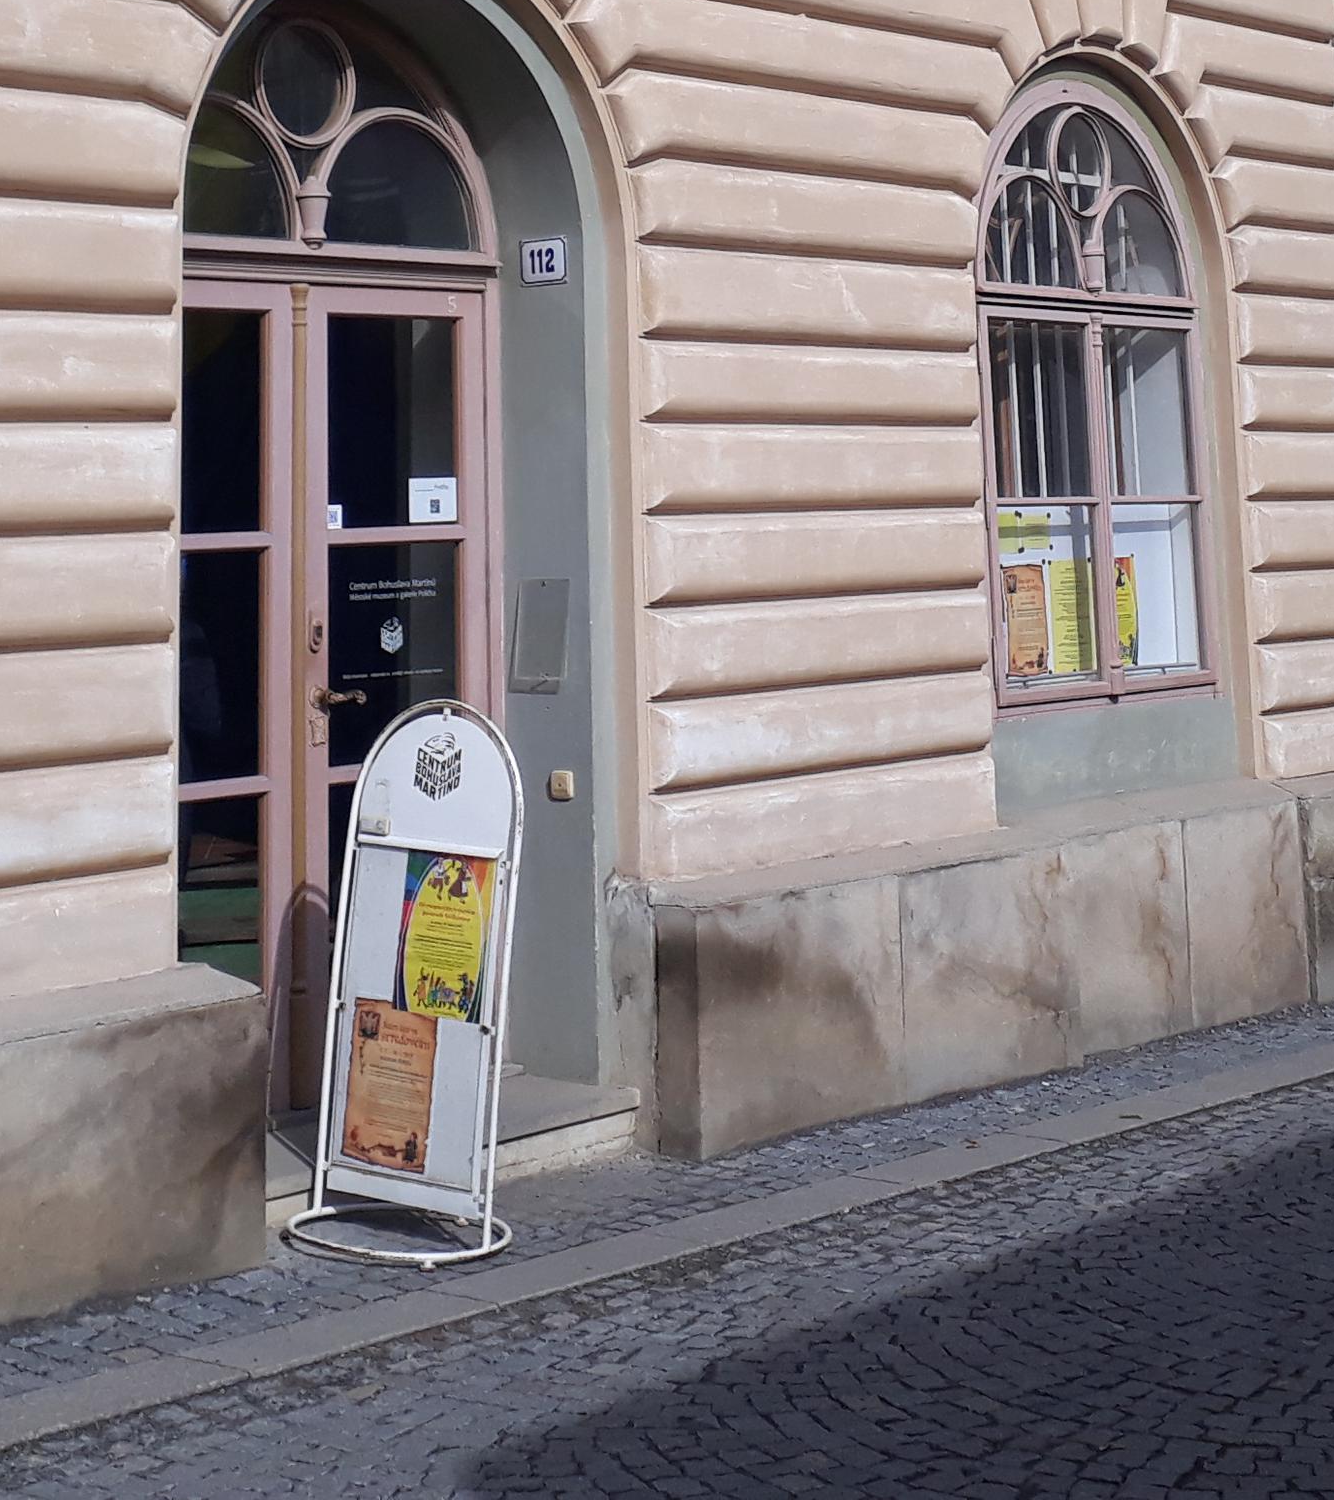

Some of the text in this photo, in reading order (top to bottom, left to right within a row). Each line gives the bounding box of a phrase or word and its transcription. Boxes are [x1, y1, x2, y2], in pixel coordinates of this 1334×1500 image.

[529, 247, 556, 275] 112
[447, 296, 457, 313] 5
[349, 582, 378, 591] Centrum
[417, 747, 462, 774] CENTRUM
[415, 761, 461, 786] BOHUSLAVA
